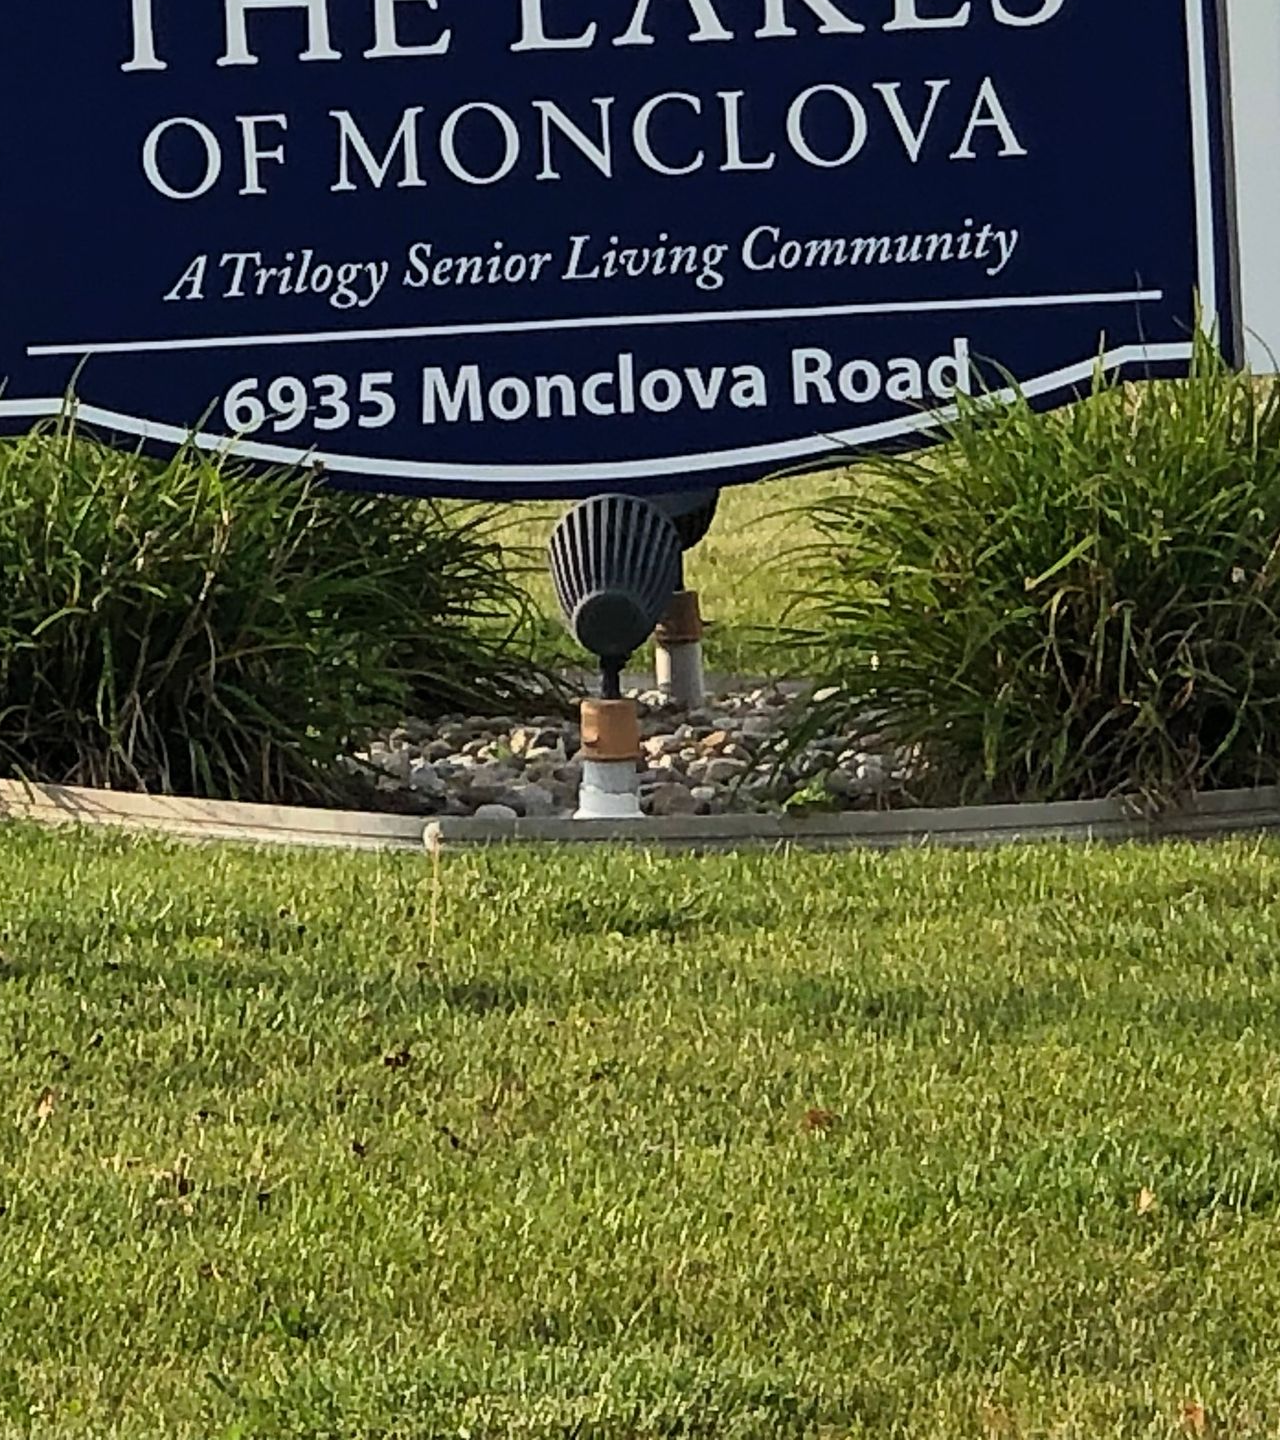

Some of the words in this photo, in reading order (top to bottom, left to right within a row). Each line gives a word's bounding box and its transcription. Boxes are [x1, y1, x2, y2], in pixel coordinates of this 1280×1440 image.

[142, 113, 288, 199] OF
[328, 76, 1028, 192] MONCLOVA
[163, 254, 207, 301] A
[219, 250, 389, 309] Trilogy
[402, 242, 552, 288] Senior
[561, 235, 729, 290] Living
[742, 219, 1019, 277] Community
[223, 371, 396, 433] 6935
[422, 352, 767, 424] Monclova
[791, 337, 971, 405] Road
